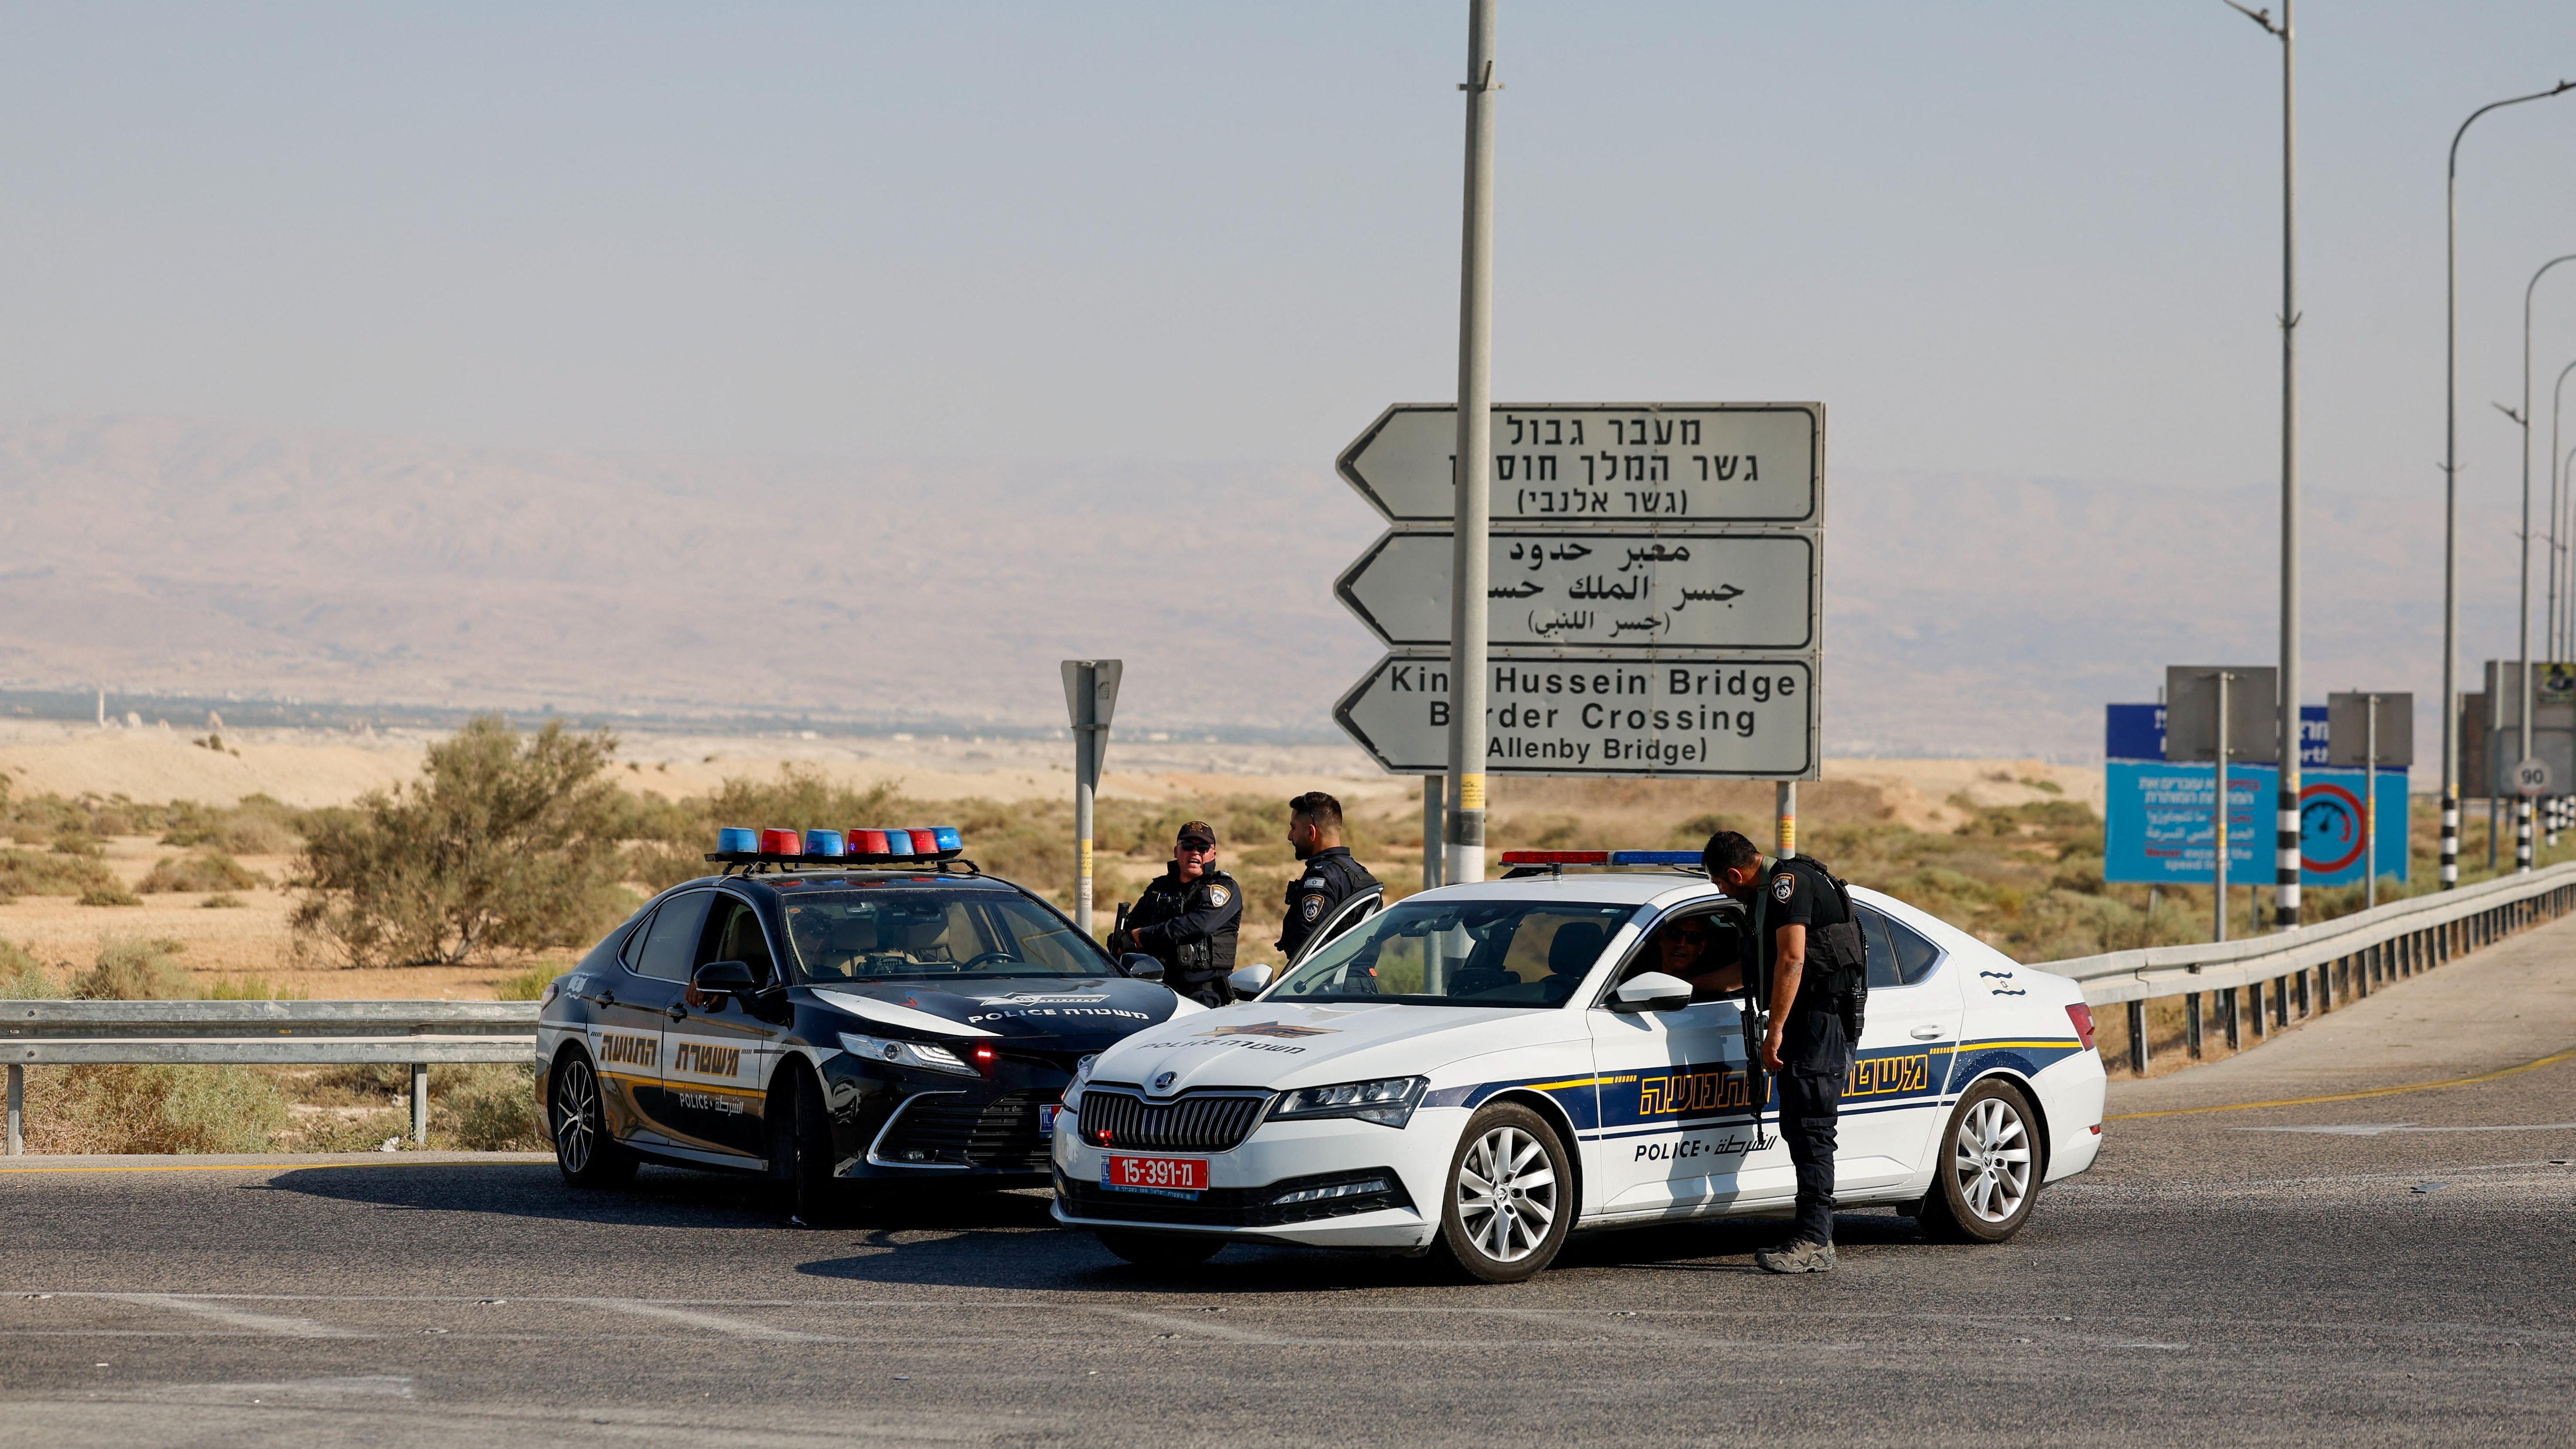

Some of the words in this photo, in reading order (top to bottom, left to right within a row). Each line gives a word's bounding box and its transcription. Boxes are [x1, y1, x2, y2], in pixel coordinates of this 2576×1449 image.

[1506, 414, 1584, 445] גבול
[1608, 417, 1700, 445] מעבר
[1580, 450, 1669, 486] המלך
[1692, 455, 1759, 481] גשר
[1517, 487, 1608, 514] אלנבי)
[1625, 489, 1687, 515] (גשר
[1510, 542, 1593, 571] حدود
[1617, 544, 1690, 572] معبر
[1488, 581, 1545, 599] حس
[1569, 574, 1649, 600] الملك
[1671, 583, 1745, 611] جسر
[1528, 610, 1594, 638] اللنبي)
[1608, 611, 1670, 638] (جسر
[1391, 666, 1449, 692] Kin
[1496, 667, 1646, 694] Hussein
[1670, 669, 1795, 703] Bridge
[1430, 701, 1558, 728] Brder
[1582, 703, 1755, 738] Crossing
[1487, 736, 1591, 764] Allenby
[1604, 737, 1707, 766] Bridge)
[2521, 768, 2544, 784] 90
[968, 1009, 1057, 1024] POLICE
[1062, 1008, 1150, 1020] משטרה
[599, 1032, 659, 1068] התנועה
[674, 1041, 741, 1078] משטרת
[1221, 1040, 1306, 1054] משטרה
[1841, 1054, 1928, 1097] משט
[679, 1093, 709, 1110] POLICE
[1639, 1068, 1773, 1115] תנועה
[715, 1094, 744, 1117] الشرطة
[1043, 1114, 1050, 1124] IL
[1634, 1140, 1701, 1162] POLICE
[1102, 1164, 1109, 1176] IL
